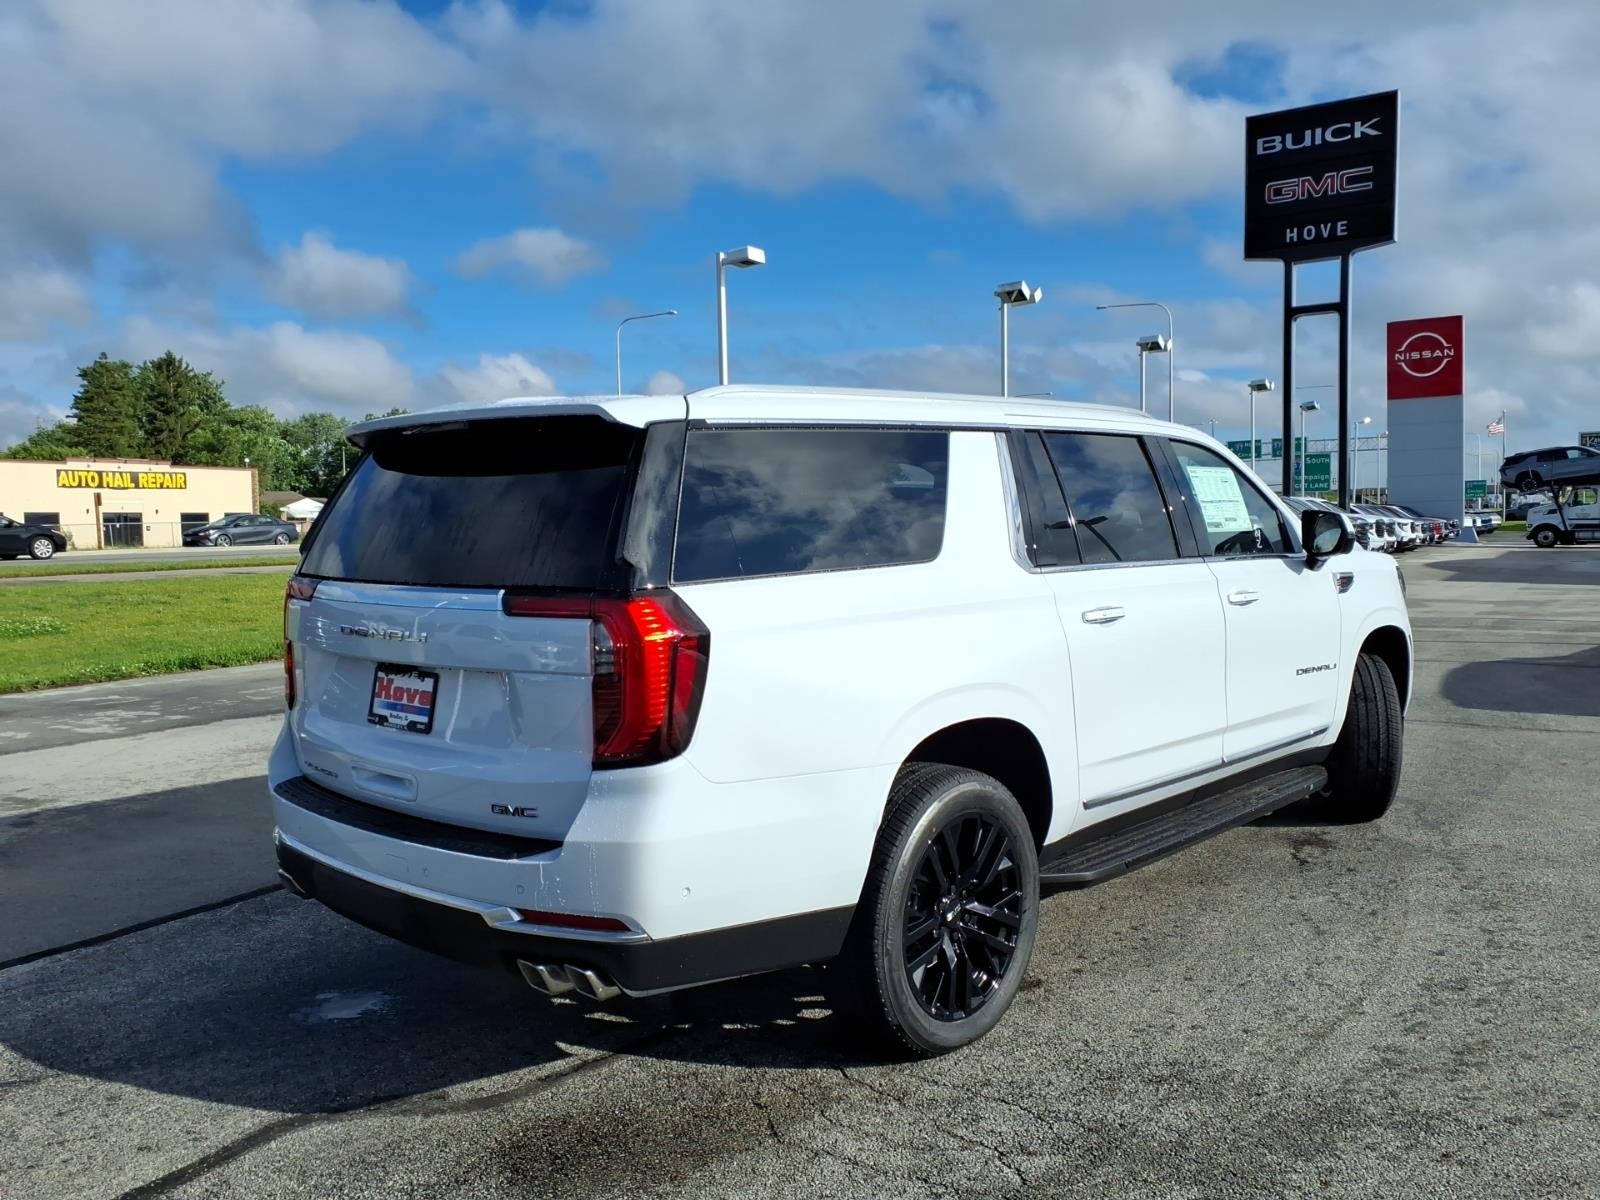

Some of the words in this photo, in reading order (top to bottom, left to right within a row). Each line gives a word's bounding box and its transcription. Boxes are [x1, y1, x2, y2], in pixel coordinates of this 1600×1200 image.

[1257, 117, 1382, 155] BUICK
[1265, 166, 1374, 204] GMC
[1286, 220, 1348, 243] HOVE
[1395, 348, 1454, 361] NISSAN
[58, 470, 99, 487] AUTO
[102, 472, 135, 488] HAIL
[138, 472, 185, 488] REPAIR
[340, 624, 428, 643] DENALI
[1296, 663, 1337, 676] DENALI
[375, 676, 433, 706] Hove
[491, 804, 538, 818] GMC
